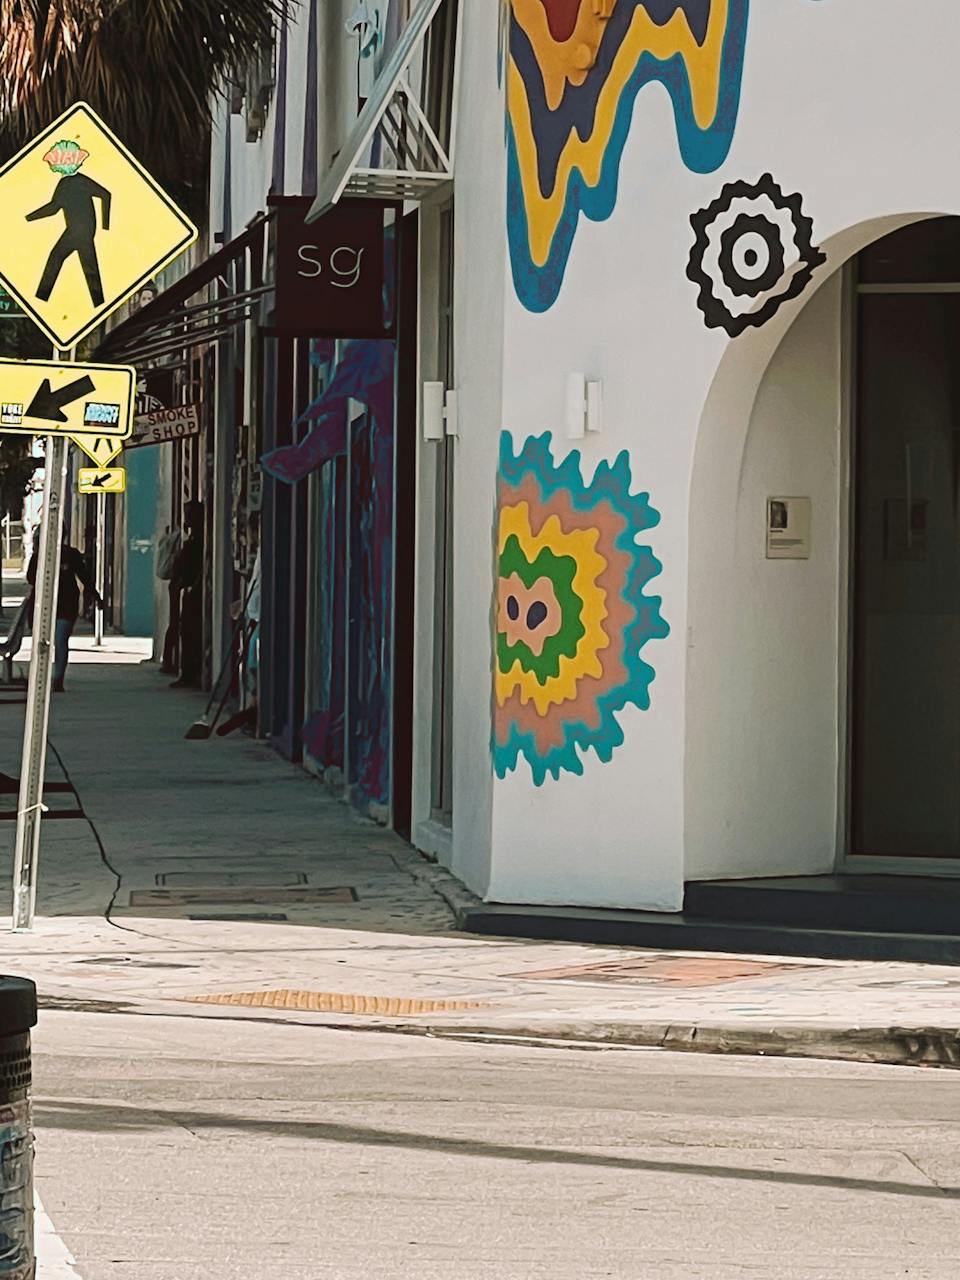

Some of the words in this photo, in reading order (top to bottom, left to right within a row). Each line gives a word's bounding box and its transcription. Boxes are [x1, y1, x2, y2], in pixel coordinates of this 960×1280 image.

[297, 244, 365, 288] sg
[147, 408, 195, 426] SMOKE
[152, 421, 196, 440] SHOP
